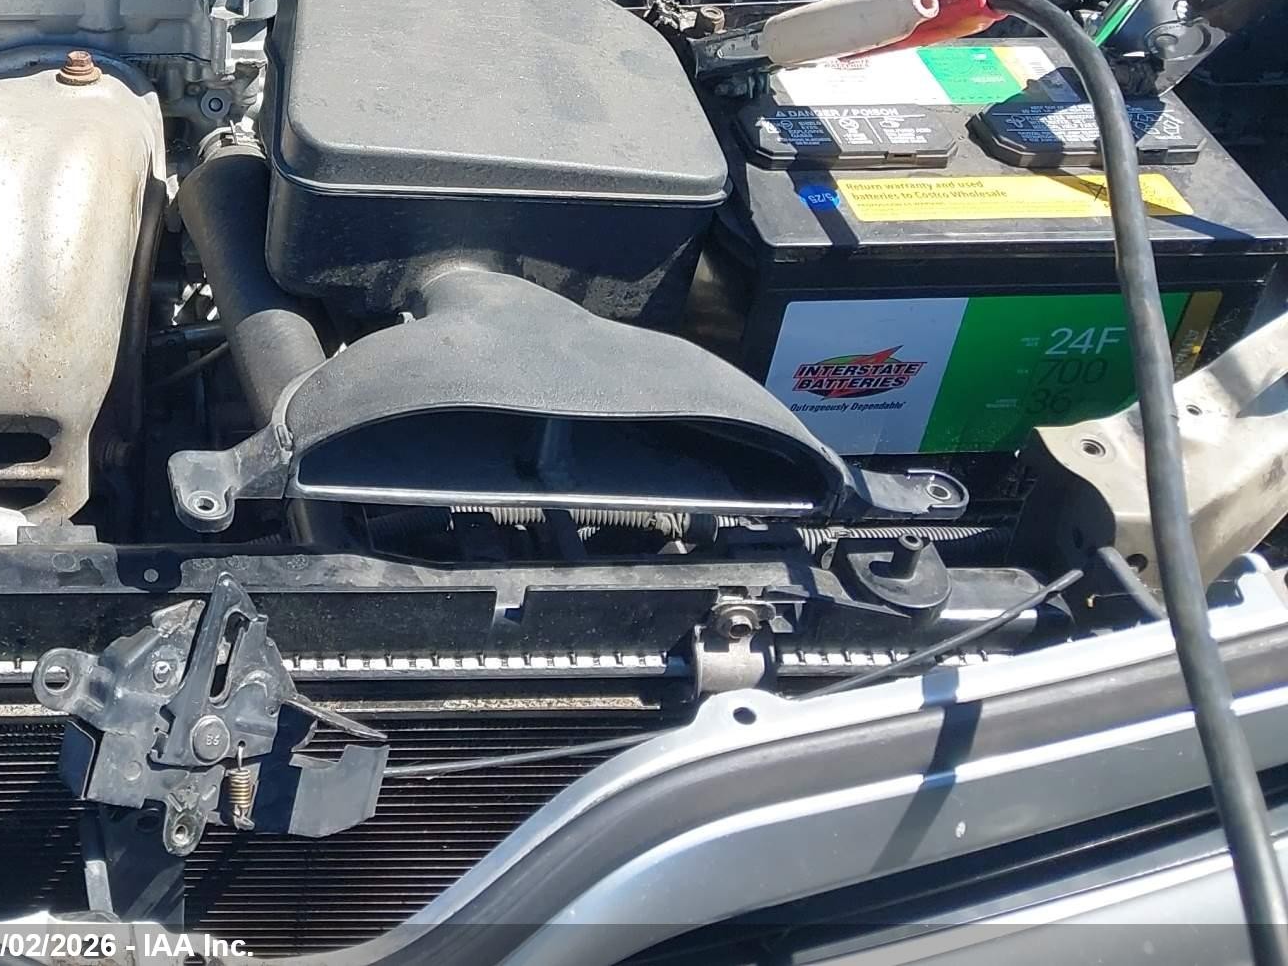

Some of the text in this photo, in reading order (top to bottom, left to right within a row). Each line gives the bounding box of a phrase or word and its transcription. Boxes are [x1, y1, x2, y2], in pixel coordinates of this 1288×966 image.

[788, 109, 839, 118] DANGER
[850, 107, 899, 117] POISON
[846, 180, 985, 192] Return warranty and used
[852, 189, 1008, 201] batteries to Costco Wholesale
[1044, 326, 1127, 355] 24F
[796, 363, 918, 377] INTERSTATE
[1037, 357, 1108, 385] 700
[797, 375, 908, 390] BATTERIES
[790, 402, 850, 413] Outrageously
[1025, 387, 1072, 415] 36
